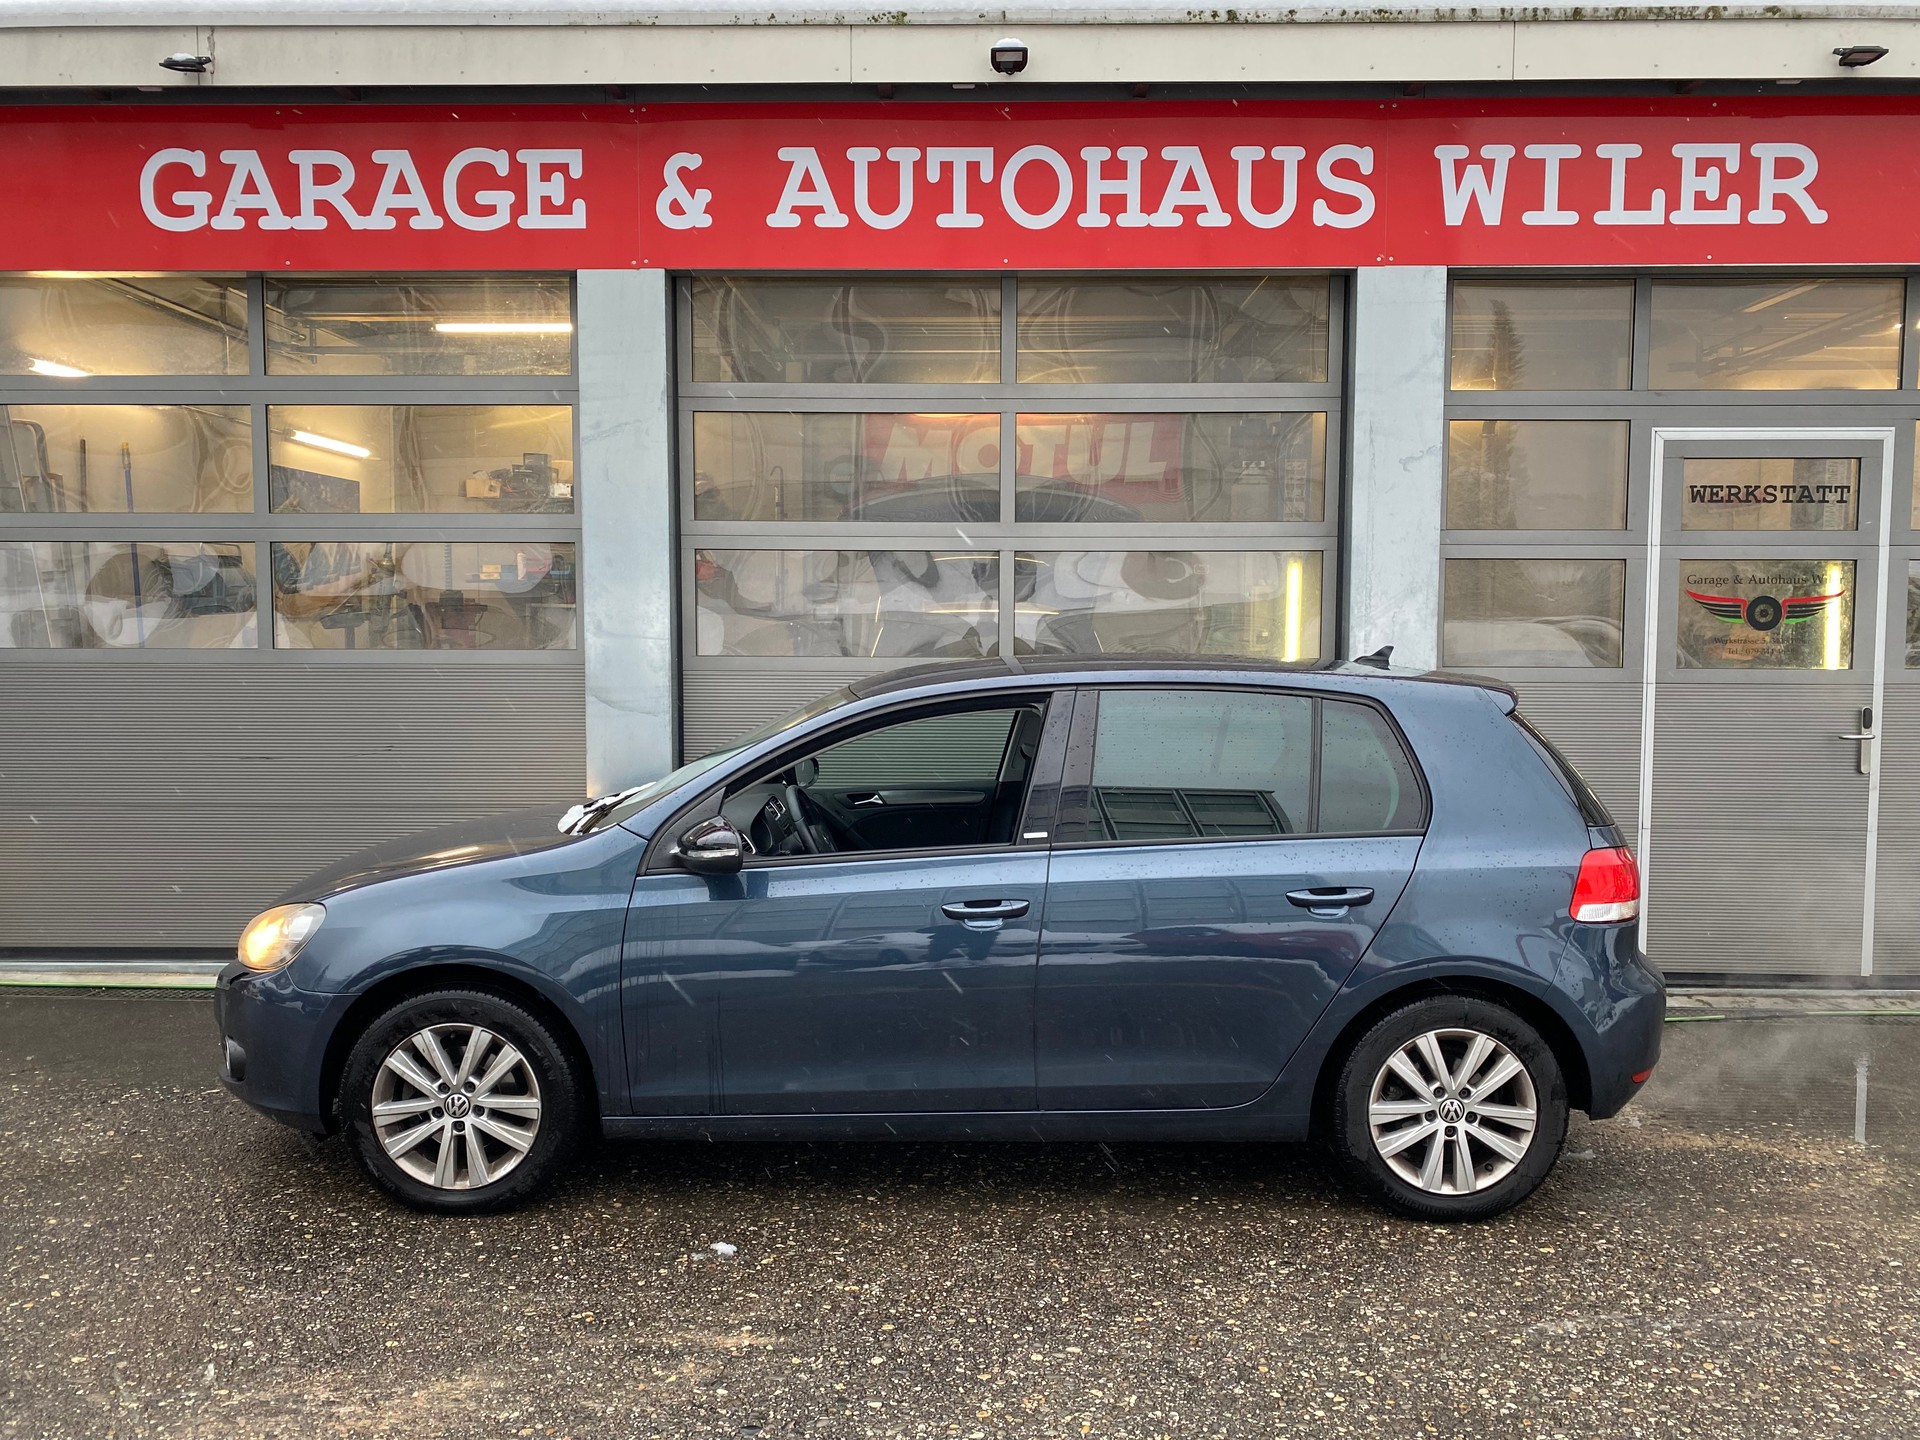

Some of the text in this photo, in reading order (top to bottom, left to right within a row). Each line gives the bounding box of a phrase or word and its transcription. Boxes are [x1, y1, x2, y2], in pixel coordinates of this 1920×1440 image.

[140, 143, 1829, 231] GARAGE & AUTOHAUS WILER
[880, 421, 1168, 485] MOTUL
[1689, 484, 1851, 504] WERKSTATT
[1686, 574, 1730, 587] Garage
[1733, 574, 1744, 585] &
[1748, 574, 1807, 585] Autohaus
